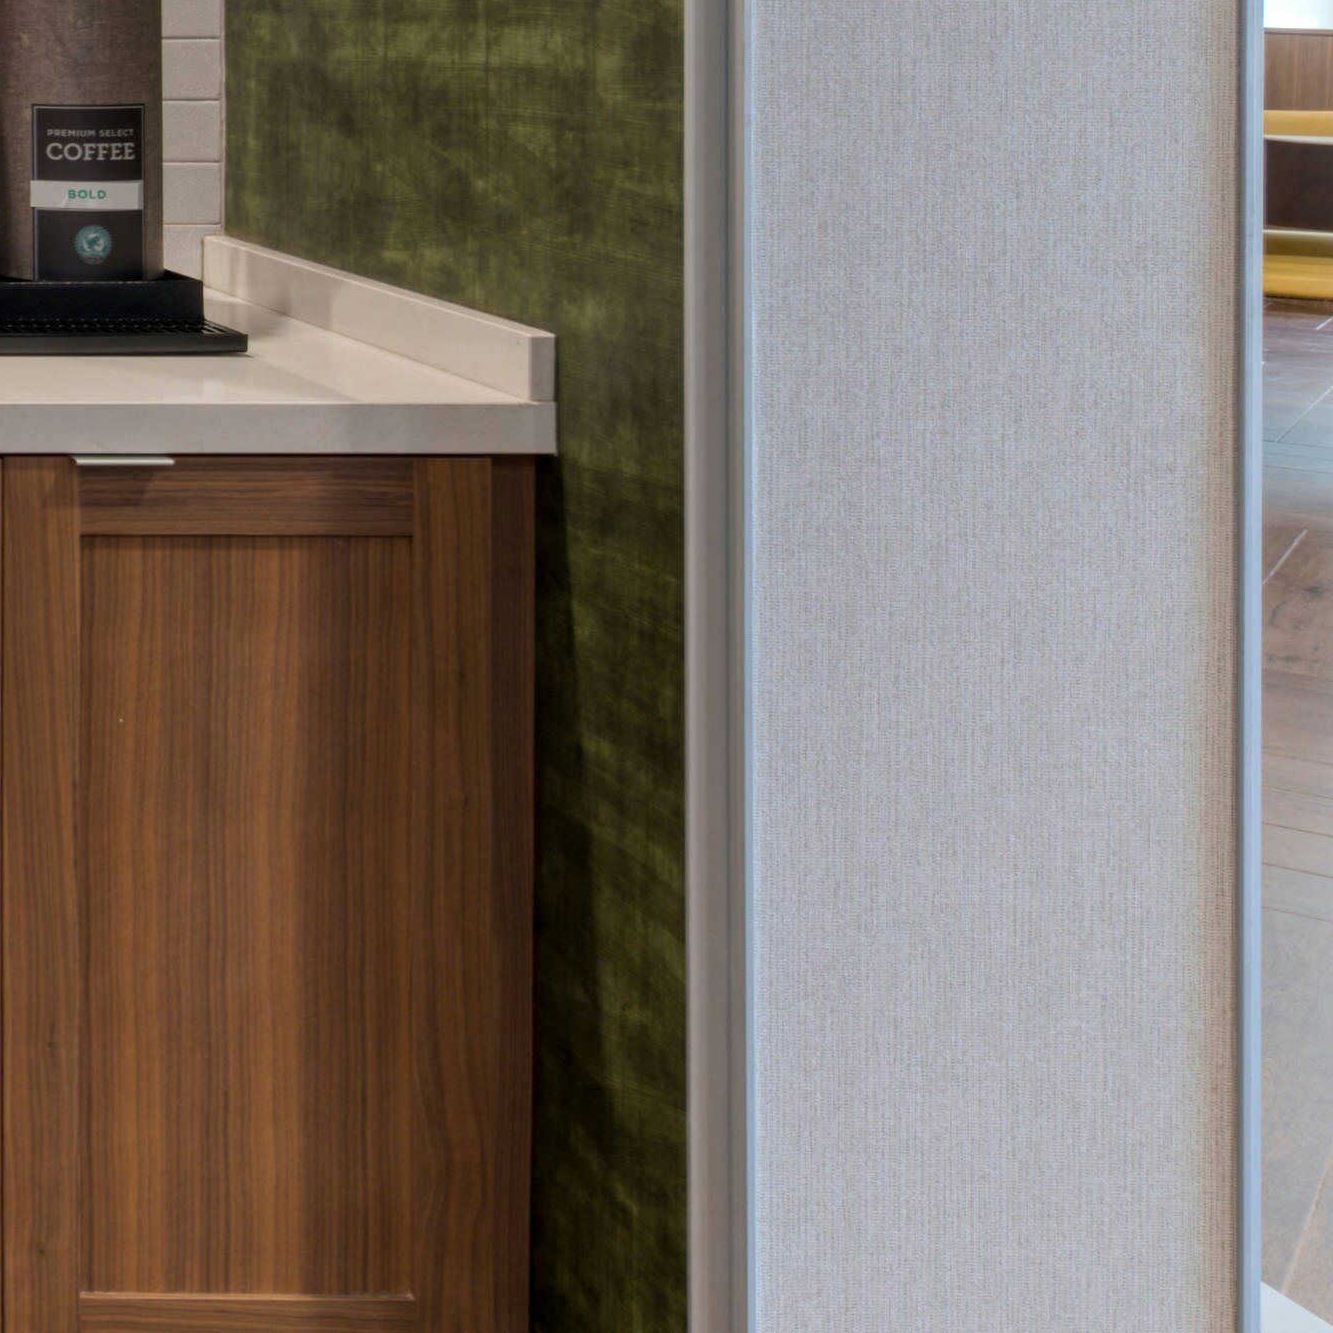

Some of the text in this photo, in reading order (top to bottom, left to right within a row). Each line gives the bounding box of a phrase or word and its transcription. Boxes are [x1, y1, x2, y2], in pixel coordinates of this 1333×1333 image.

[46, 129, 134, 138] PREMIUM SELECT
[45, 142, 135, 161] COFFEE
[68, 189, 107, 199] BOLD
